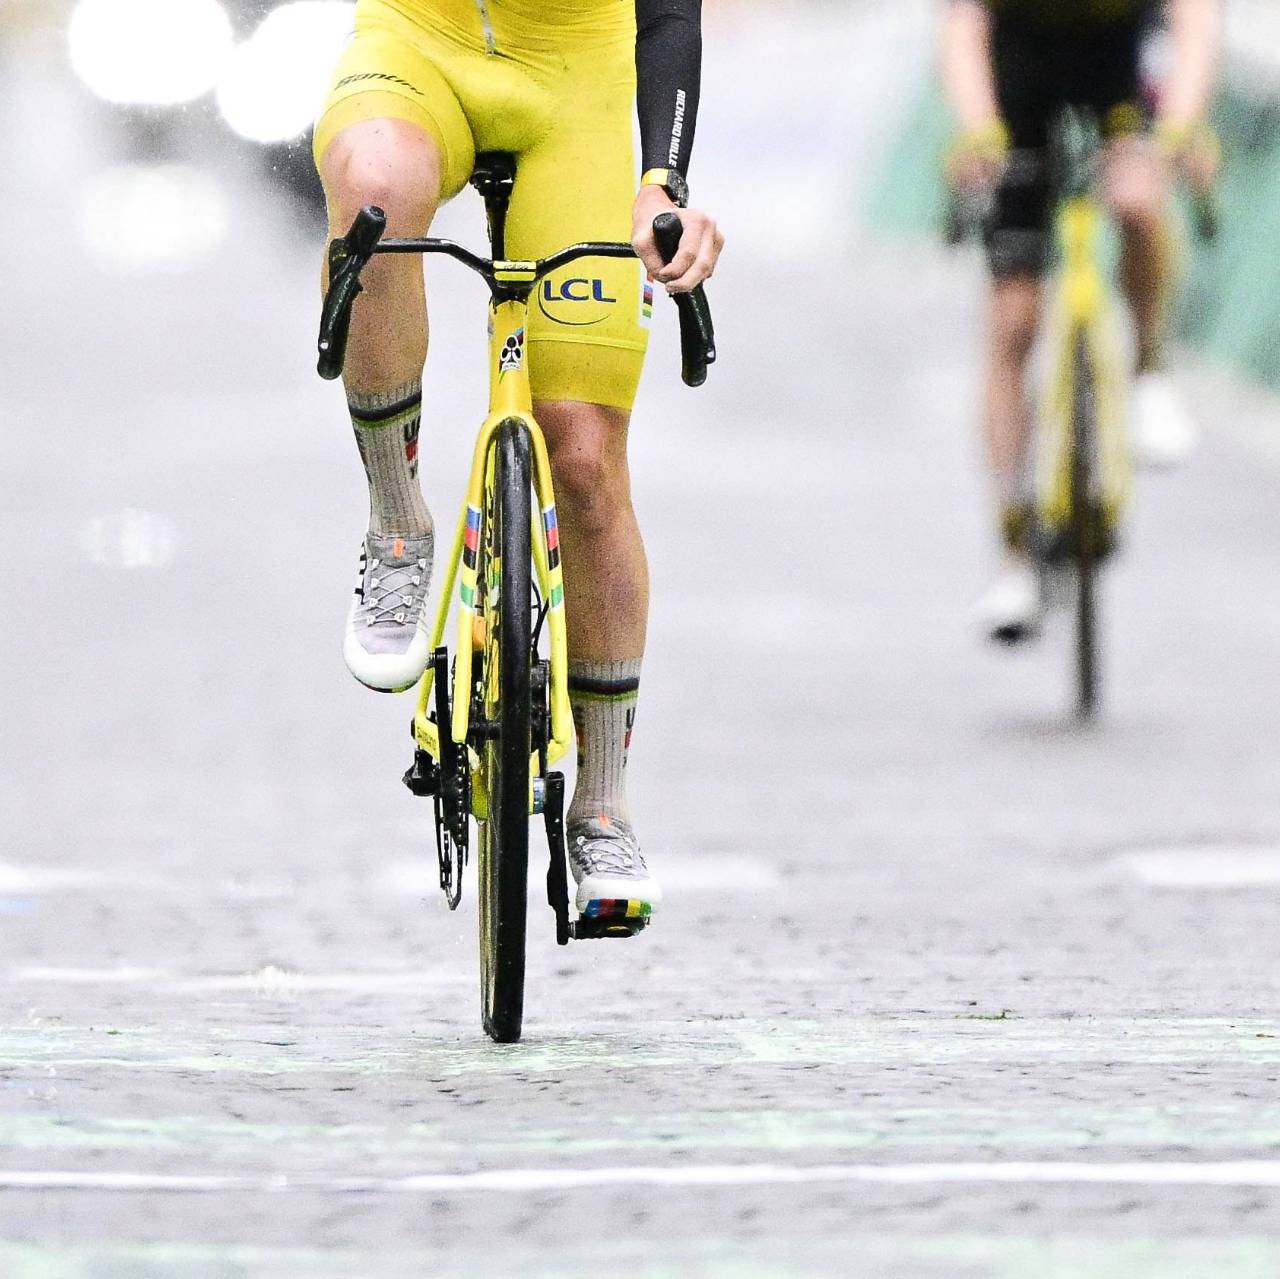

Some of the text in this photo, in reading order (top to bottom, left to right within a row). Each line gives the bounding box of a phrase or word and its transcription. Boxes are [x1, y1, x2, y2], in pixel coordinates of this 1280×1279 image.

[668, 88, 686, 168] RICHARD MILLE
[543, 278, 617, 303] LCL
